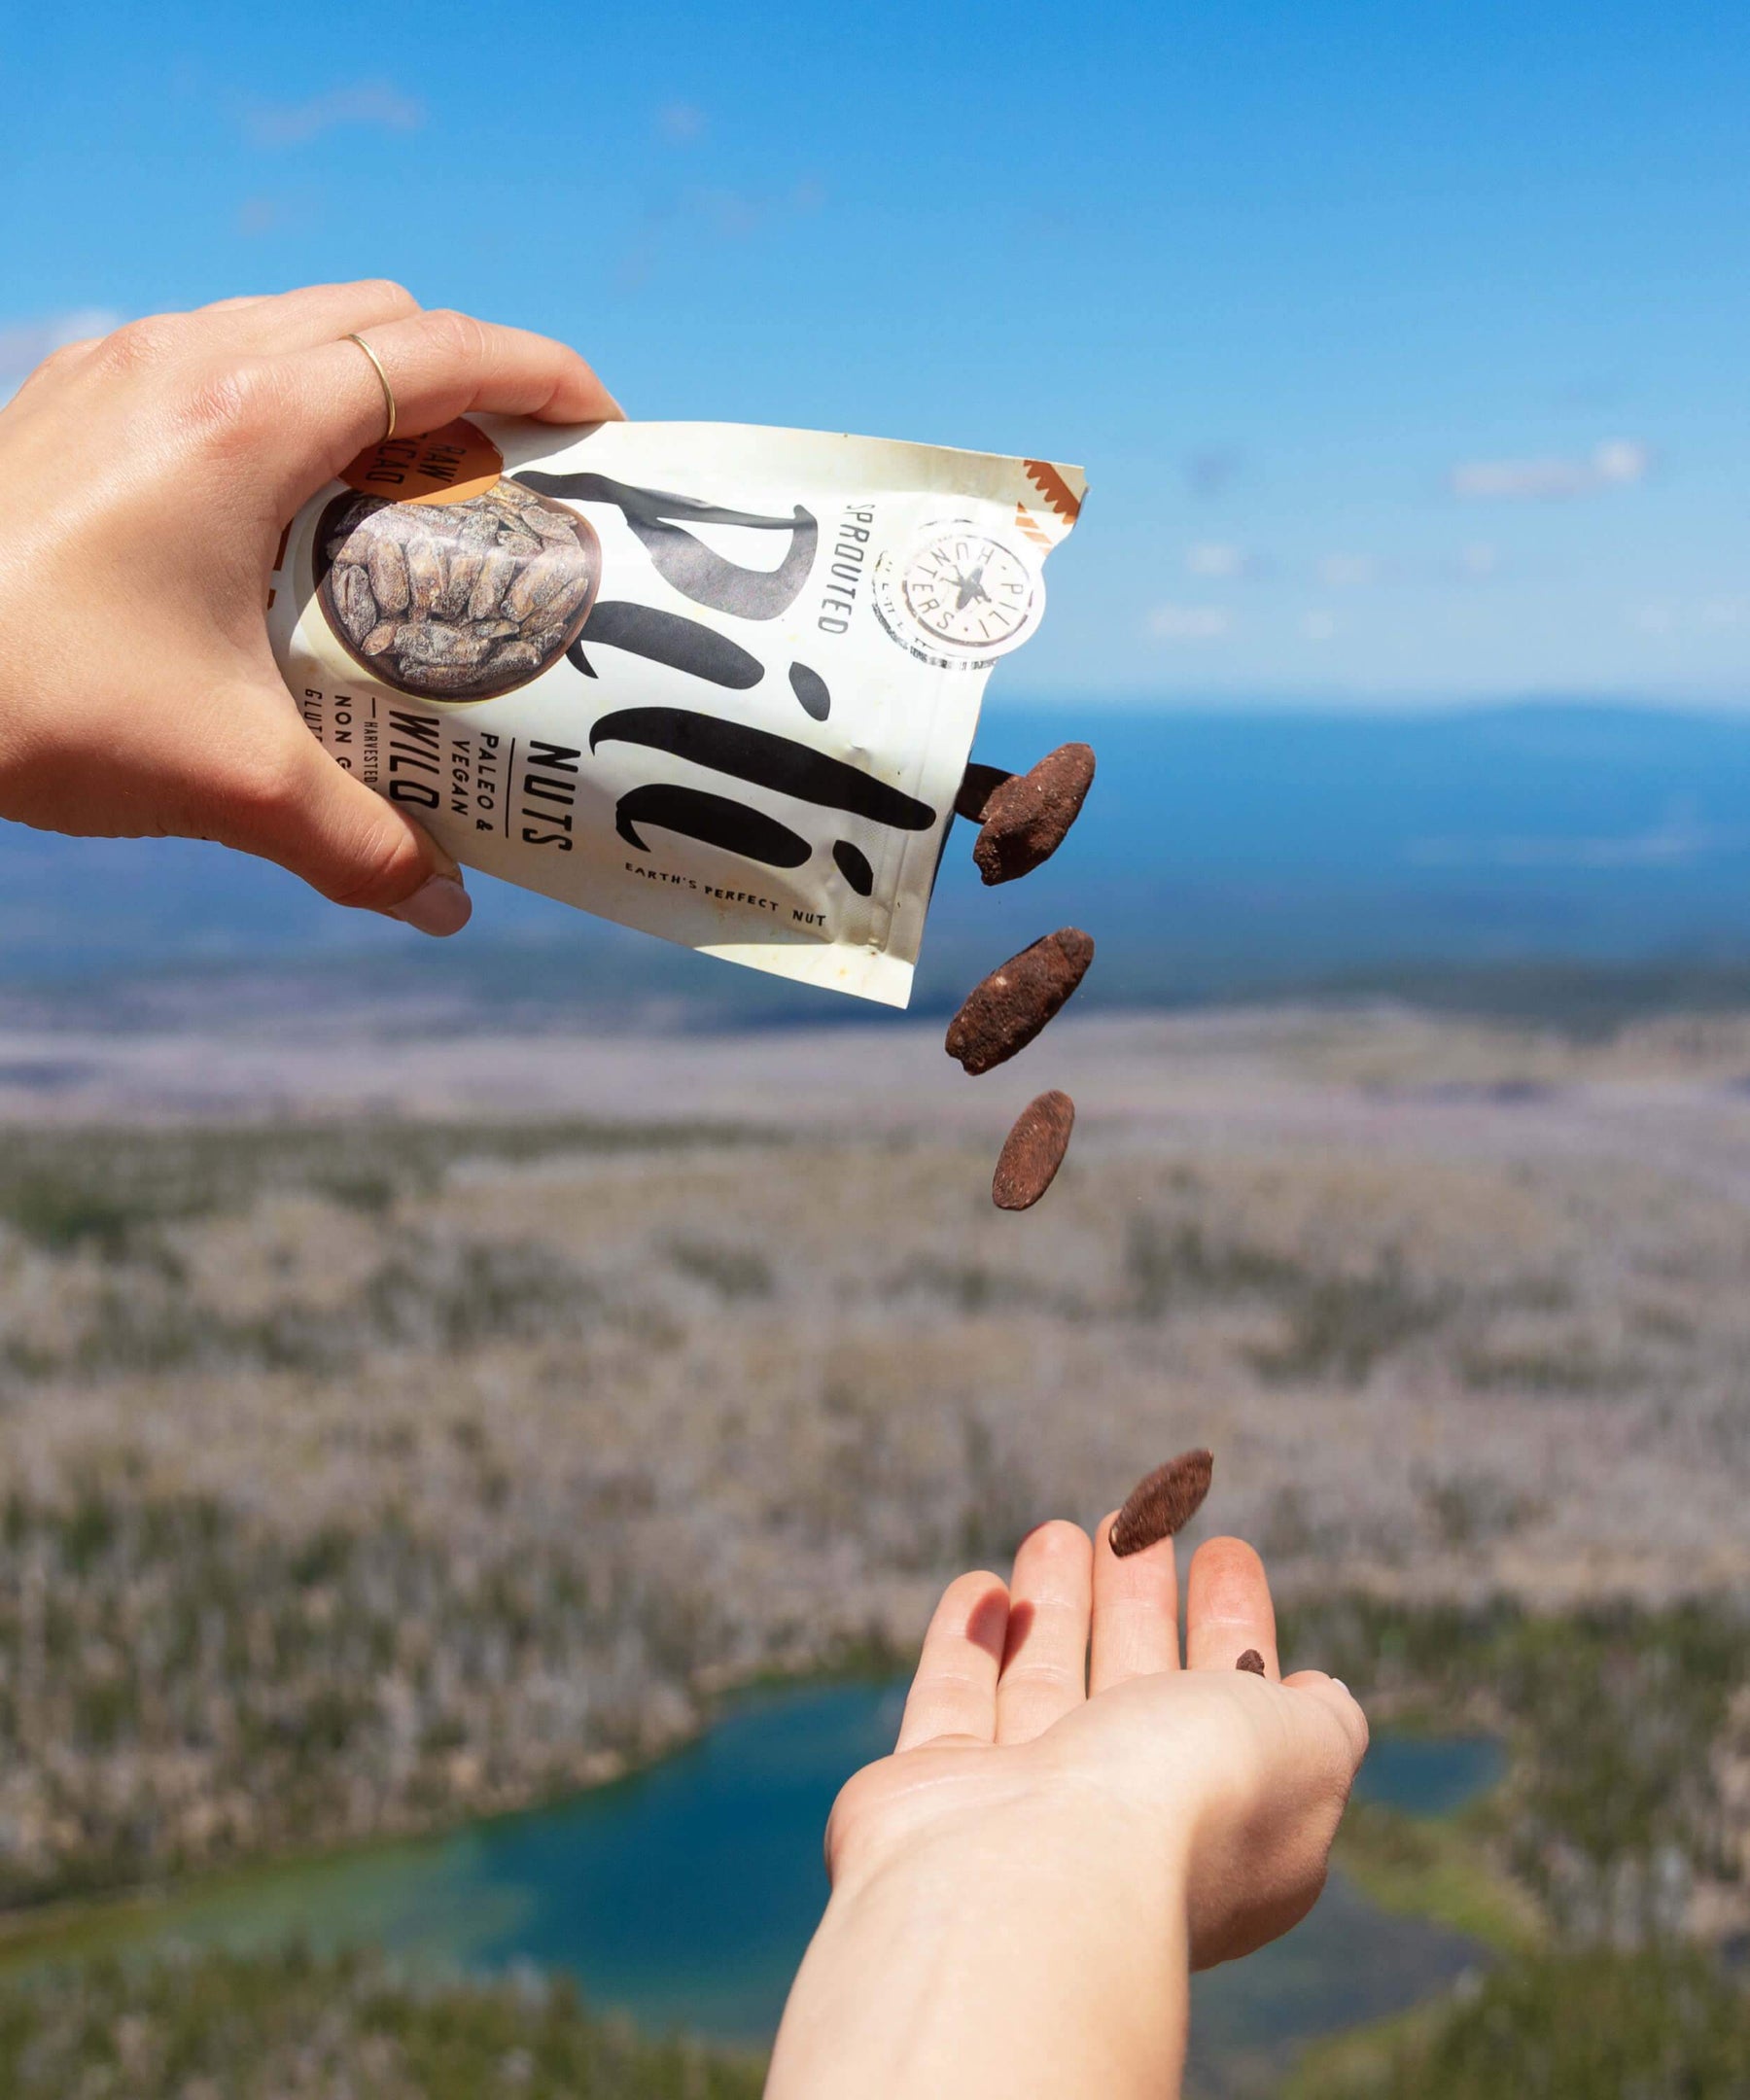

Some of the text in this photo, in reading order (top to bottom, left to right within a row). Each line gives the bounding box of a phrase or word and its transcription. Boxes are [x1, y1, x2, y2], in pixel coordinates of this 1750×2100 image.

[365, 433, 429, 485] ACAO
[417, 442, 467, 483] RAW
[818, 504, 875, 634] SPROUTED
[912, 542, 996, 631] HUNTERS
[977, 582, 1024, 639] PILI
[303, 688, 323, 743] GLUT
[334, 695, 352, 743] NON
[364, 721, 378, 783] HARVESTED
[389, 710, 440, 810] WILD
[451, 740, 471, 816] VEGAN
[475, 732, 500, 831] PALEO &
[522, 740, 581, 852] NUTS
[624, 861, 826, 927] EARTH'S PERFECT NUT
